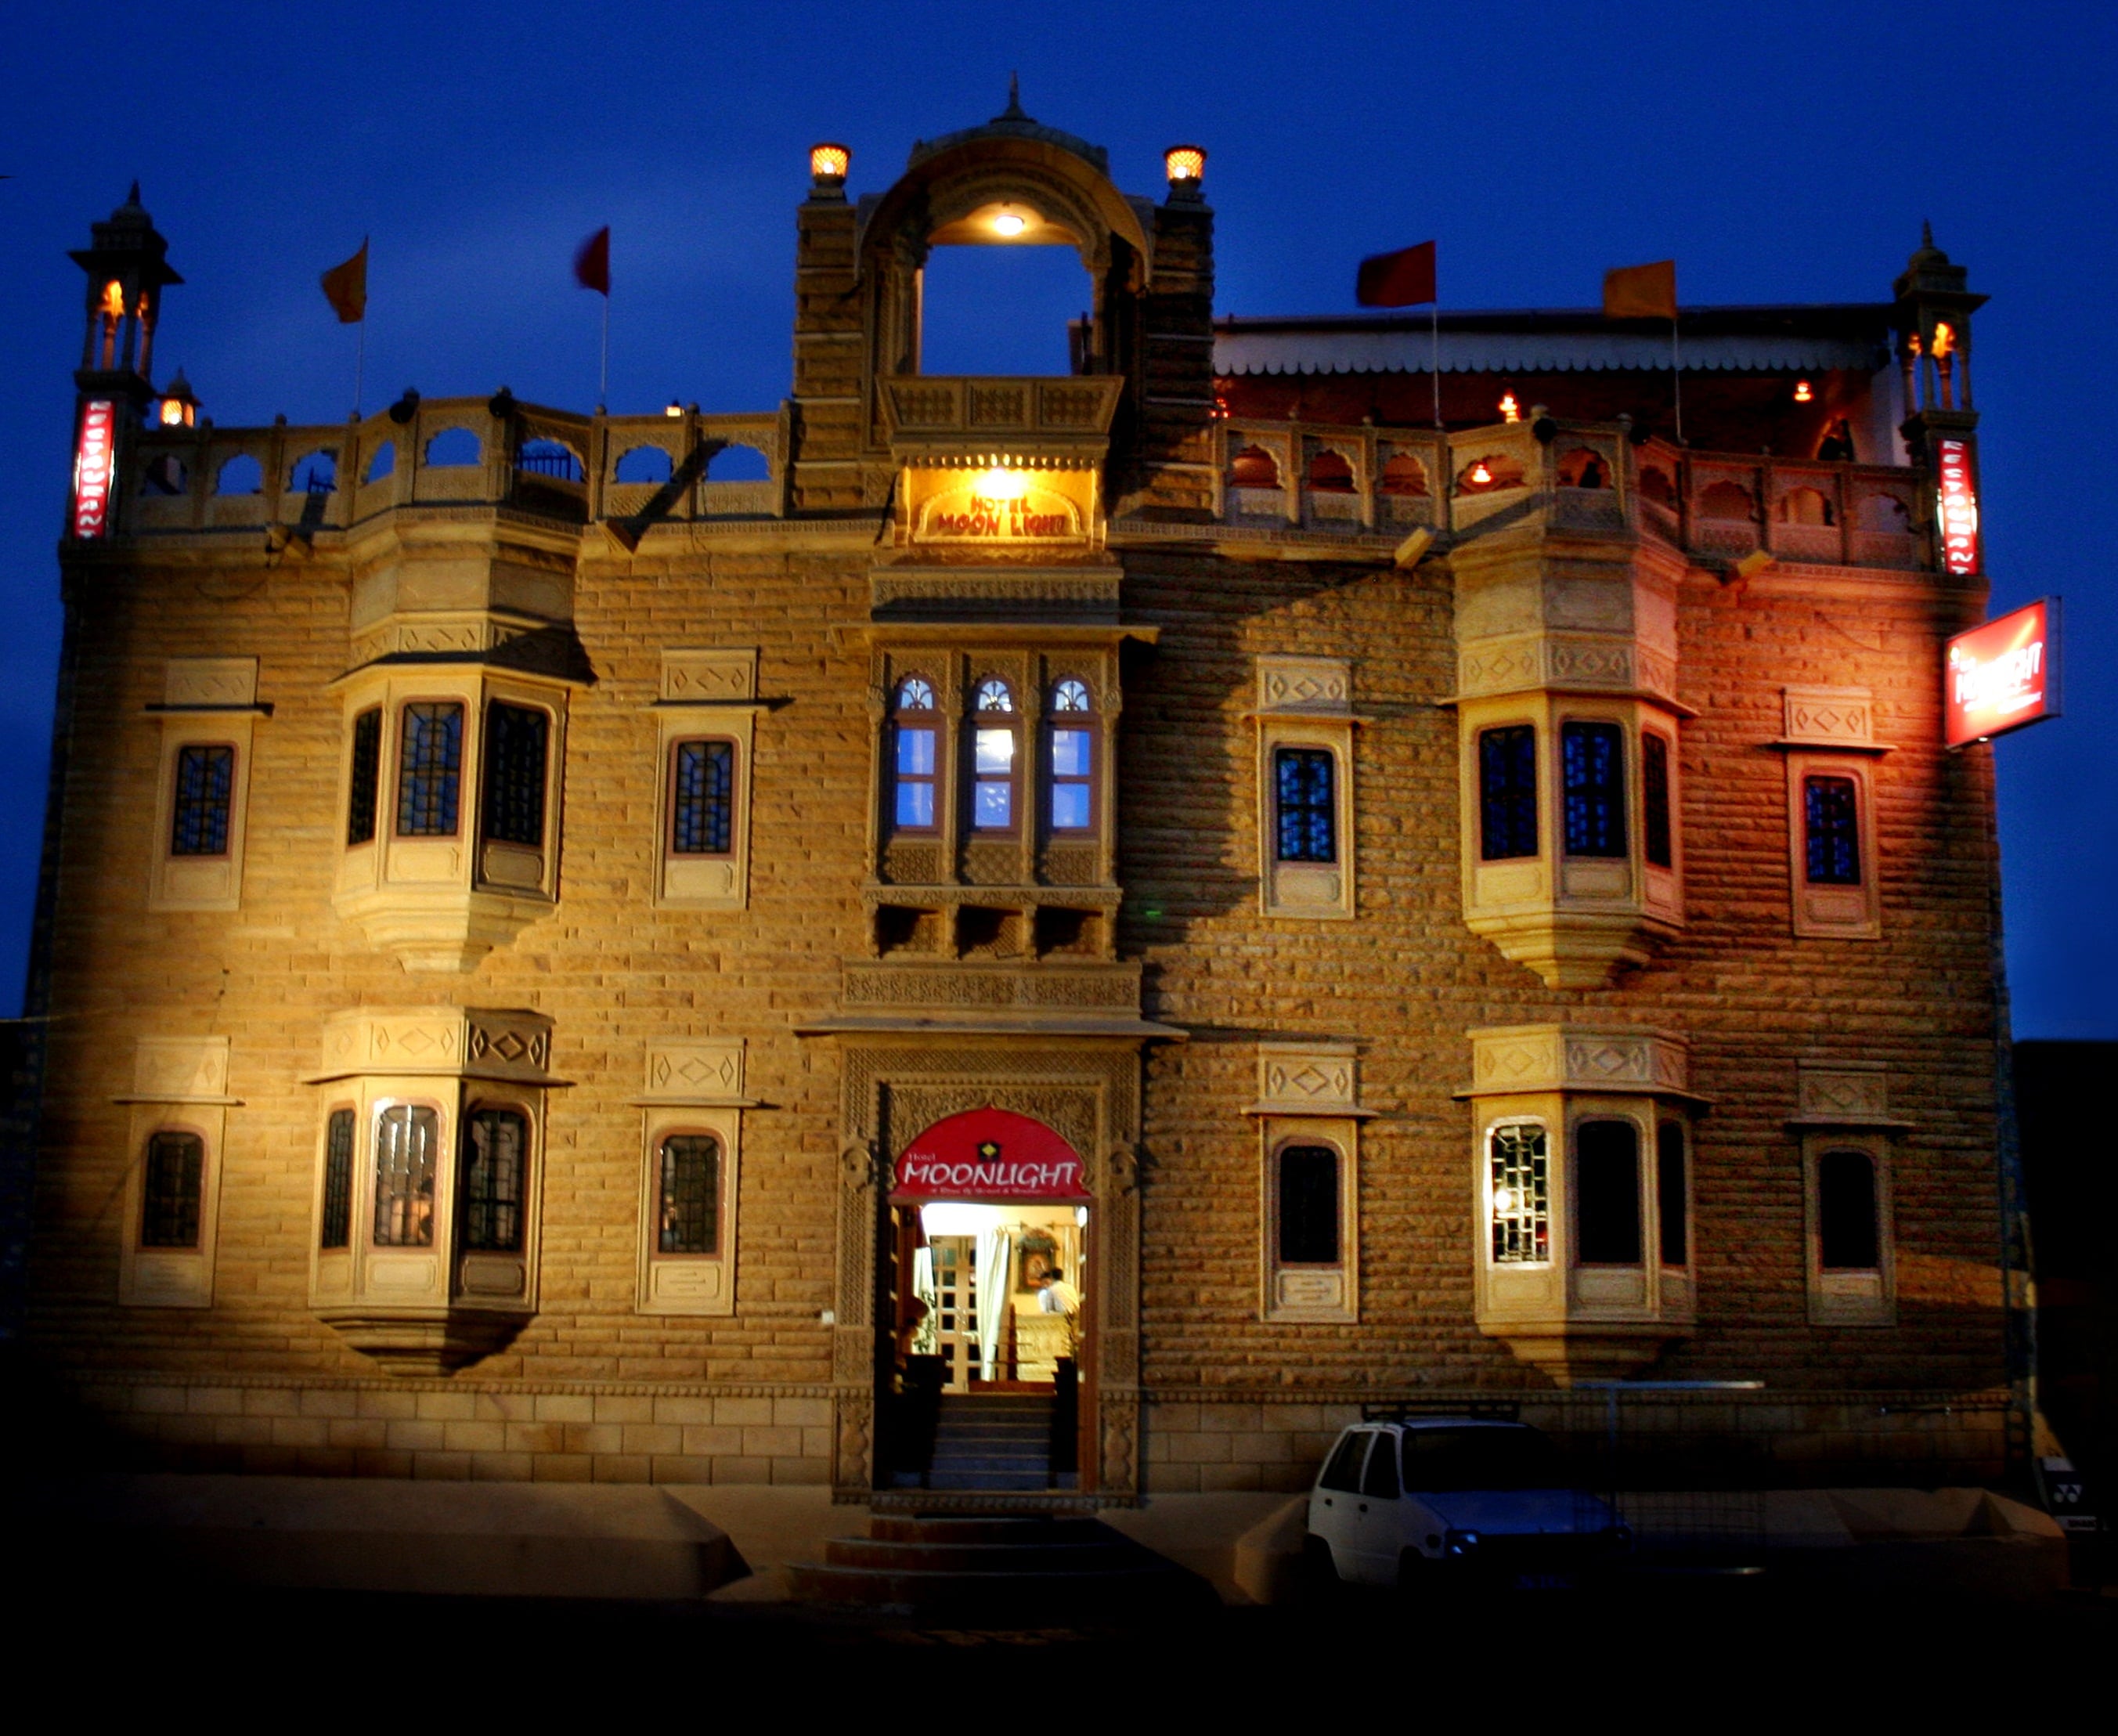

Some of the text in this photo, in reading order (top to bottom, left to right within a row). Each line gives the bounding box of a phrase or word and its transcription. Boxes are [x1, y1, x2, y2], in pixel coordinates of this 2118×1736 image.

[970, 495, 1032, 514] HOTEL
[938, 513, 999, 532] MOON
[904, 1161, 1077, 1187] MOONLIGHT
